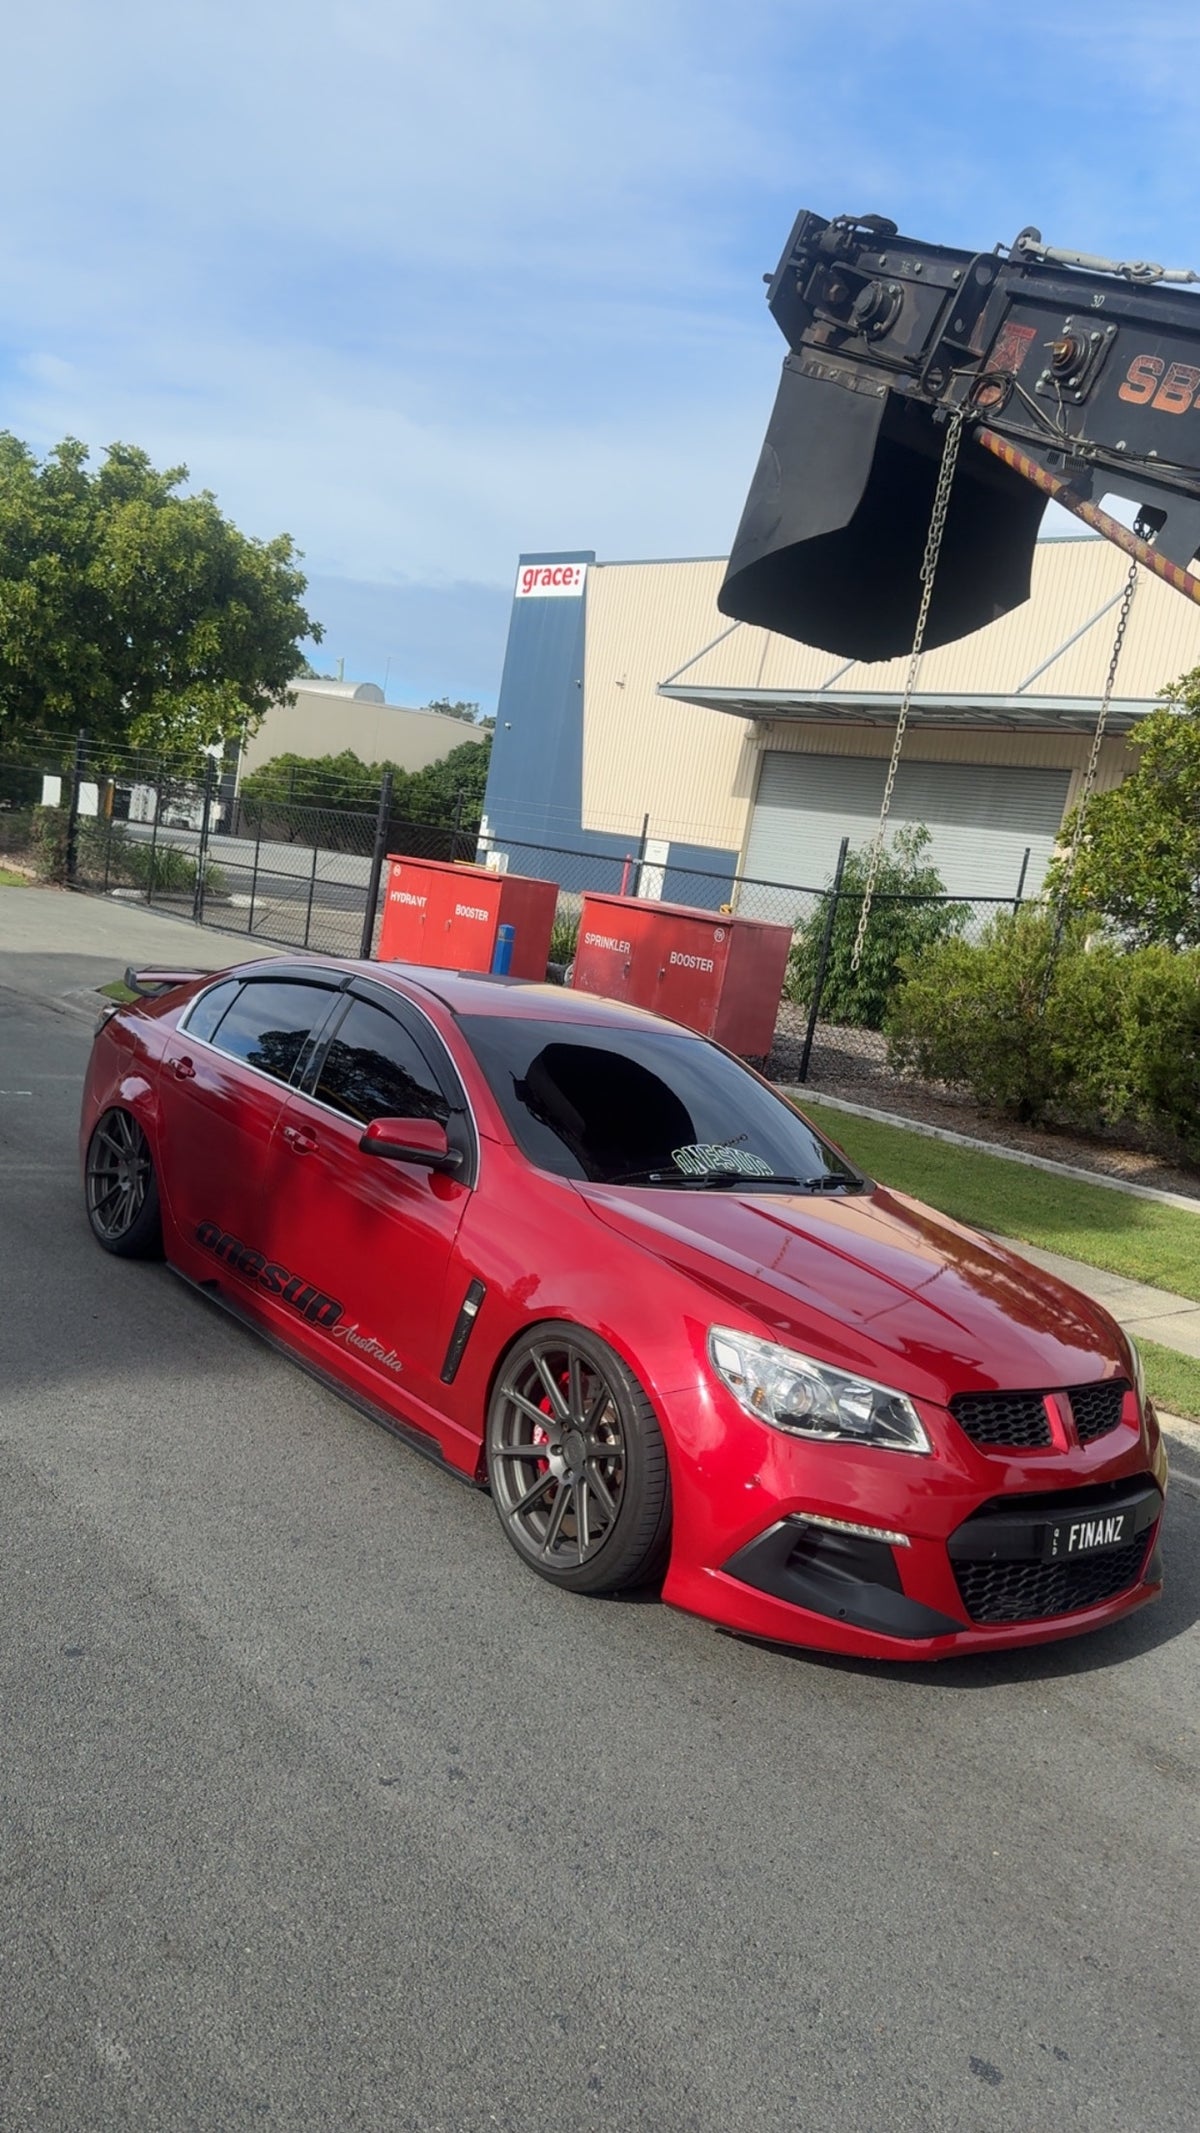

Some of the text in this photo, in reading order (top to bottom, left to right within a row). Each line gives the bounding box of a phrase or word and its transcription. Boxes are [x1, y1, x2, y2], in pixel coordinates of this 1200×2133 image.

[1118, 354, 1200, 415] SB
[390, 890, 489, 922] HYDRANT BOOSTER
[584, 932, 714, 973] SPRINKLER BOOSTER
[196, 1219, 404, 1372] onesup Australia
[1068, 1515, 1124, 1552] FINANZ
